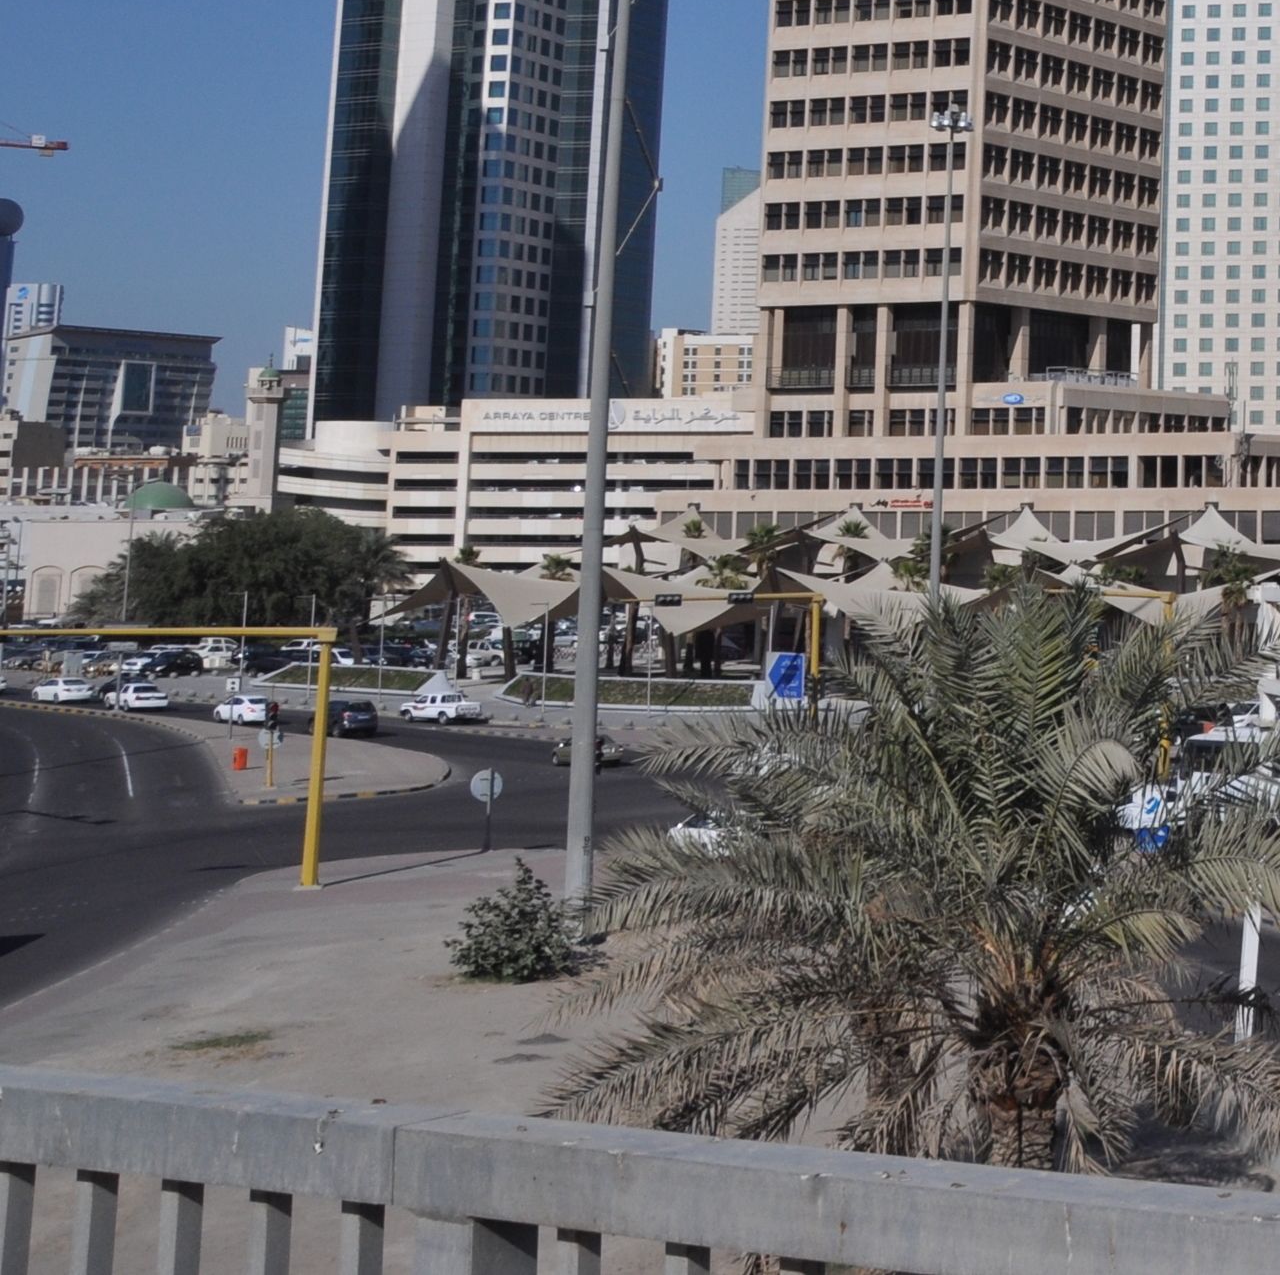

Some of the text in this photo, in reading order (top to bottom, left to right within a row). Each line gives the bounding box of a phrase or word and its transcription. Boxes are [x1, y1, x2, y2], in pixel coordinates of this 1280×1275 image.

[482, 411, 591, 421] ARRAYA CENTRE
[632, 407, 741, 425] مركز الراية
